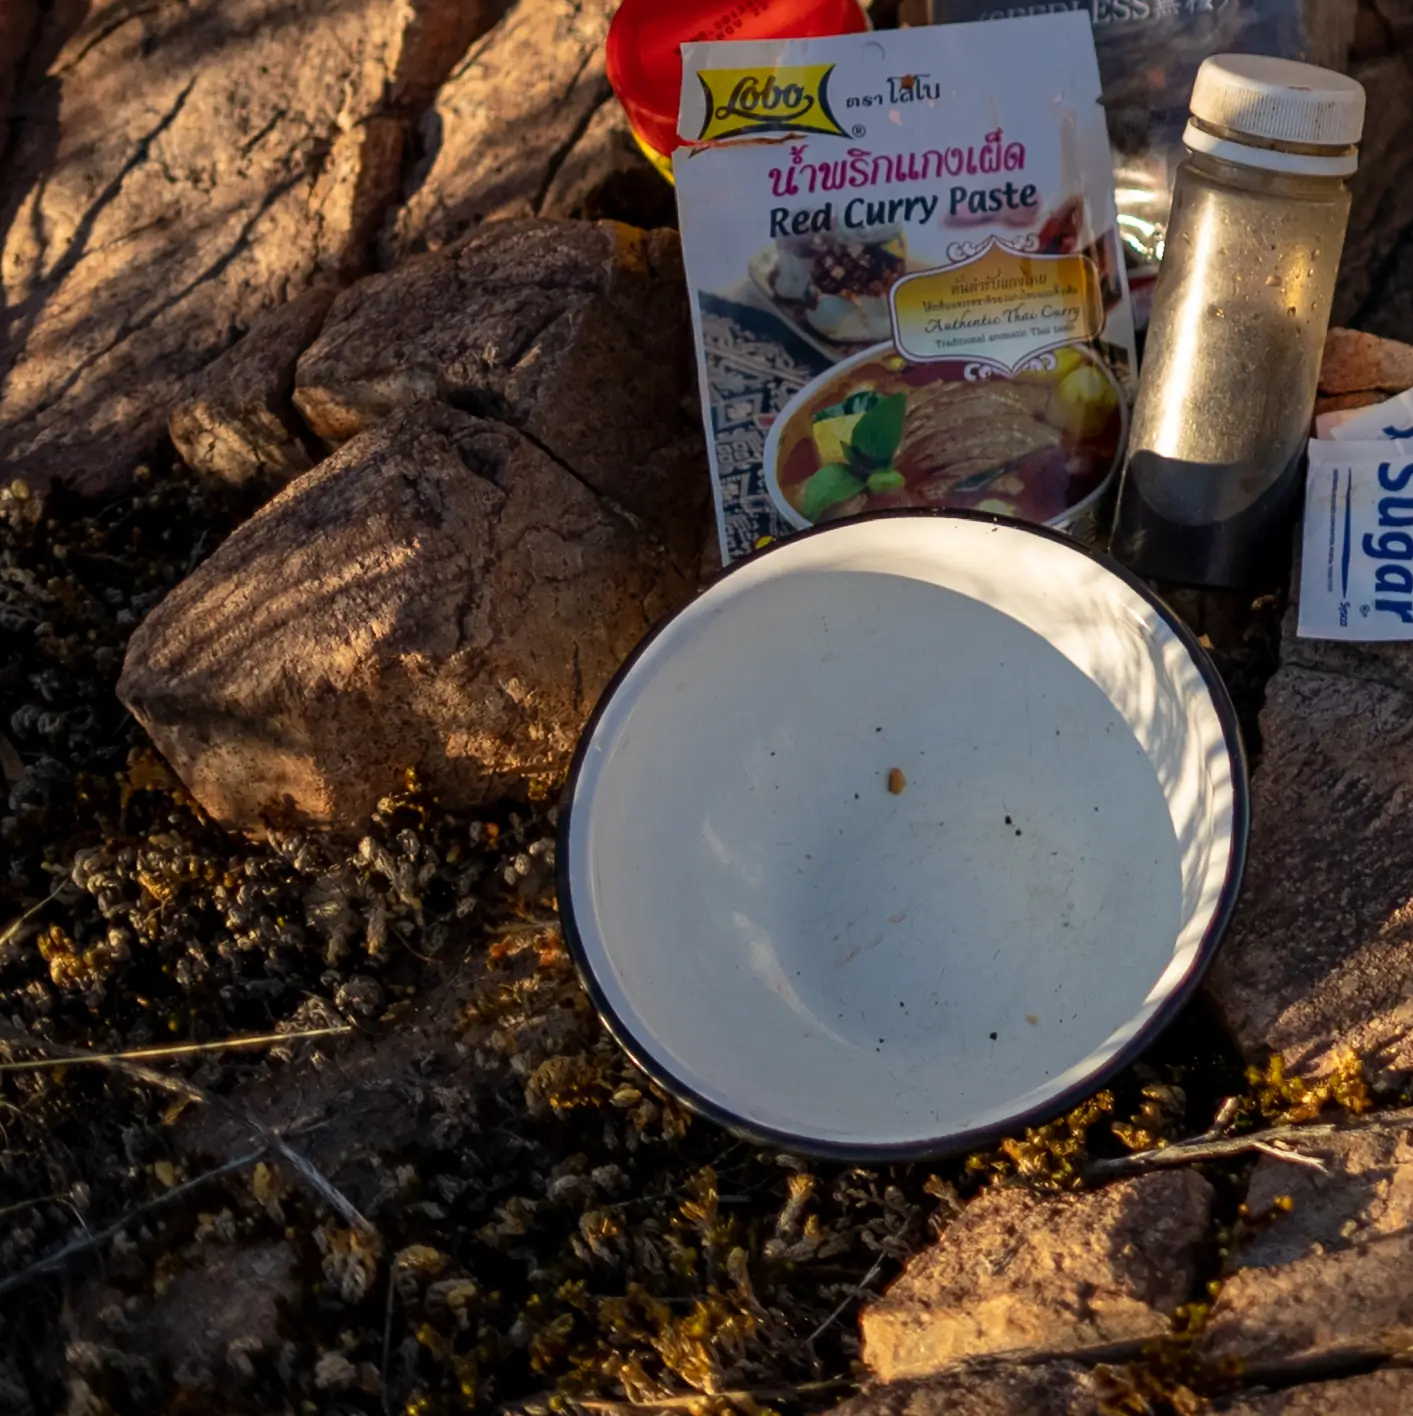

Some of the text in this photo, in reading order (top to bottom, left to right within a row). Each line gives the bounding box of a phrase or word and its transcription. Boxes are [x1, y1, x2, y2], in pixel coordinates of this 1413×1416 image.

[715, 76, 815, 121] Lobo
[768, 128, 1026, 197] น้ำพริกแกงเผ็ด
[770, 181, 1037, 237] Red Curry Paste
[925, 303, 1080, 333] Authentic Thai Curry
[936, 334, 985, 349] Traditional
[988, 330, 1027, 343] aromatic
[1031, 326, 1050, 337] Thai
